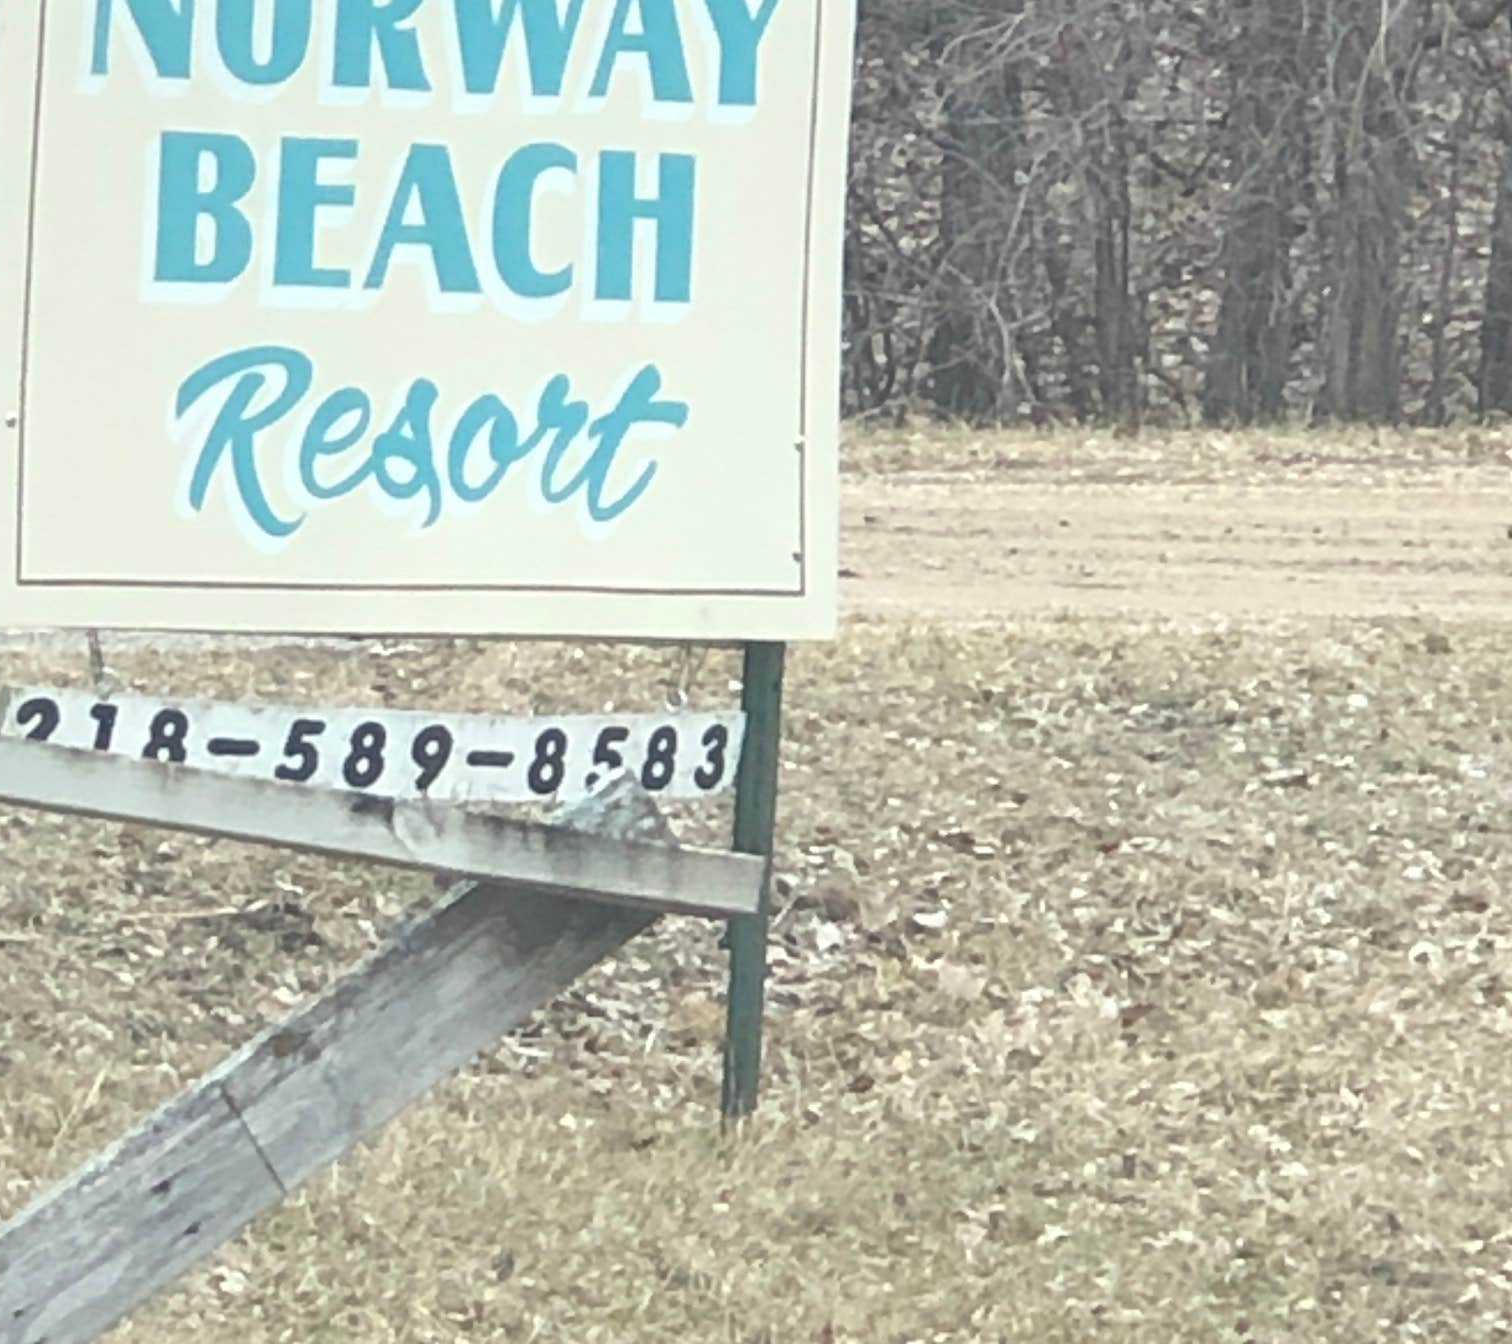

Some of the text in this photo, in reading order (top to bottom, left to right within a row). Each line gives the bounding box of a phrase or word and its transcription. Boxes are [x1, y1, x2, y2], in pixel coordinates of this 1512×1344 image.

[152, 130, 697, 303] BEACH
[175, 346, 688, 536] Resort
[15, 697, 728, 794] 218-589-8583
